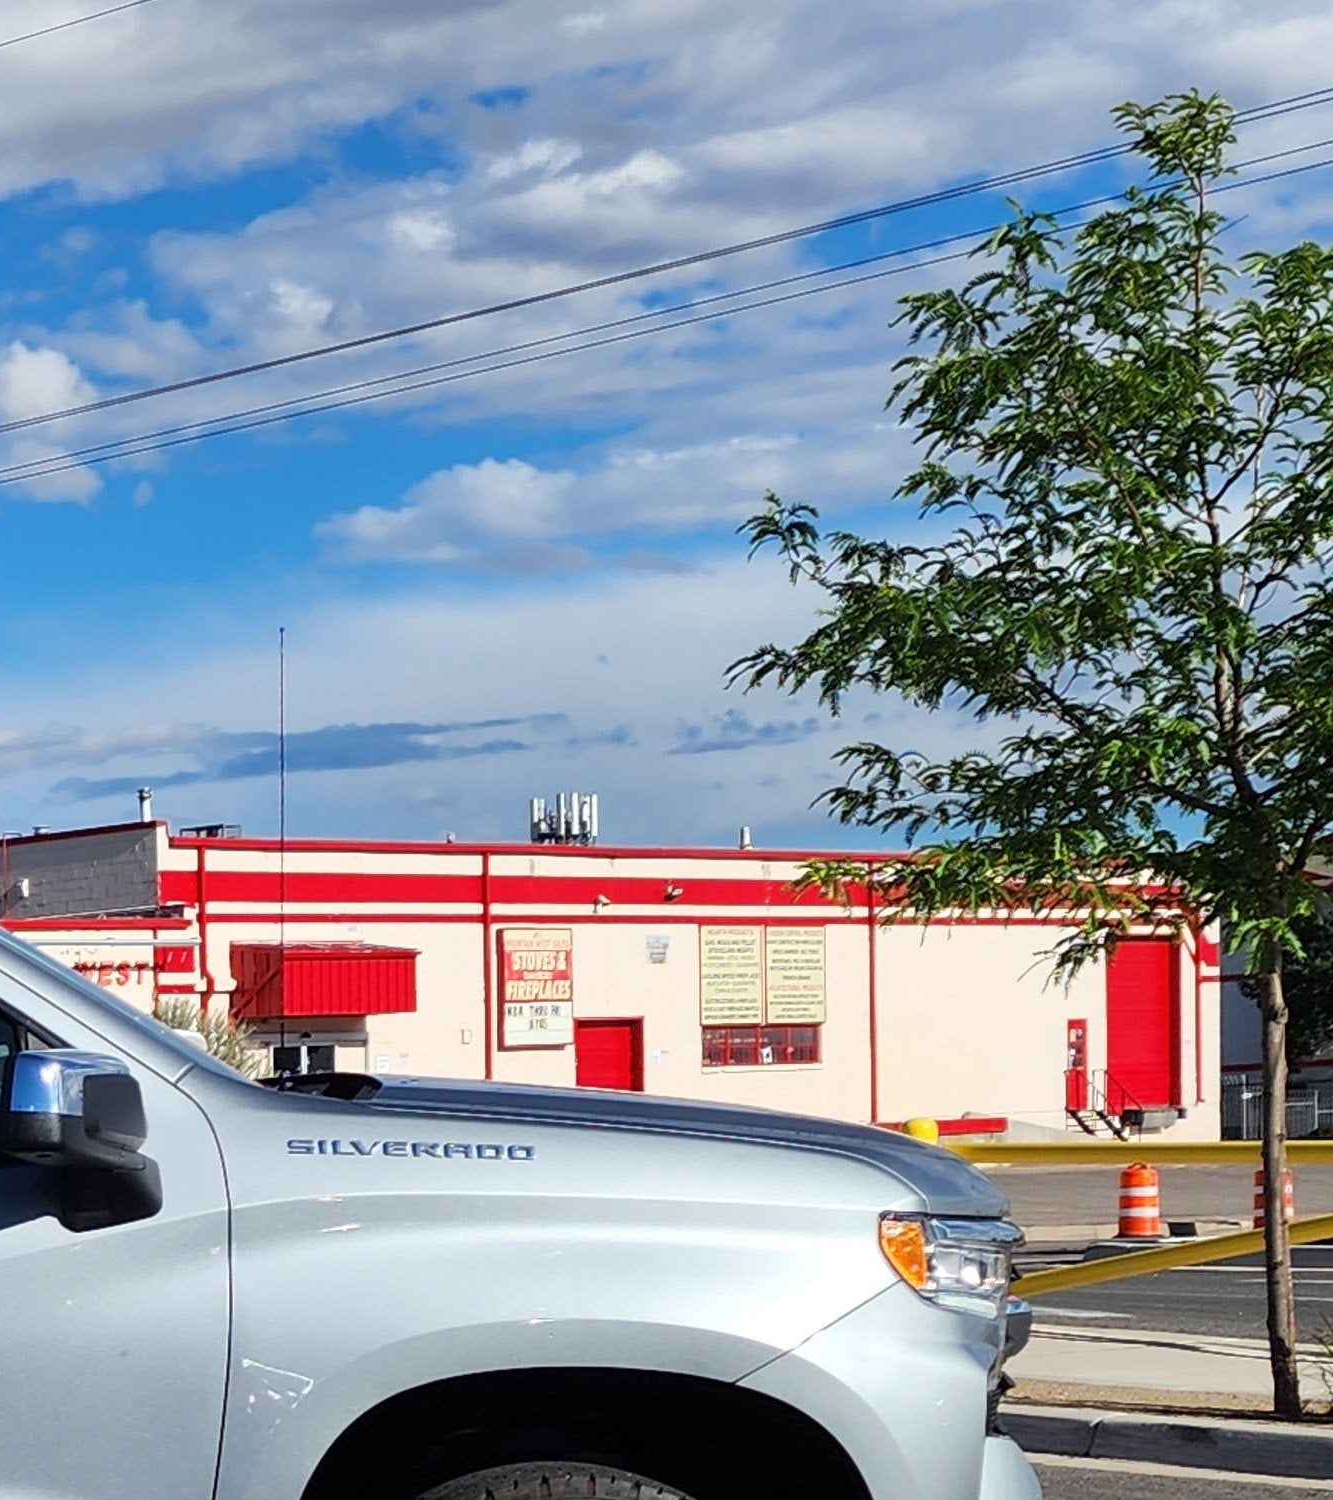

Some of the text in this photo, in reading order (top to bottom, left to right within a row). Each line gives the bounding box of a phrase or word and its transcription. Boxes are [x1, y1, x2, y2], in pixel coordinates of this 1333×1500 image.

[513, 950, 557, 971] STOVES
[505, 980, 572, 1000] FIREPLACES
[286, 1139, 537, 1161] SILVERADO
